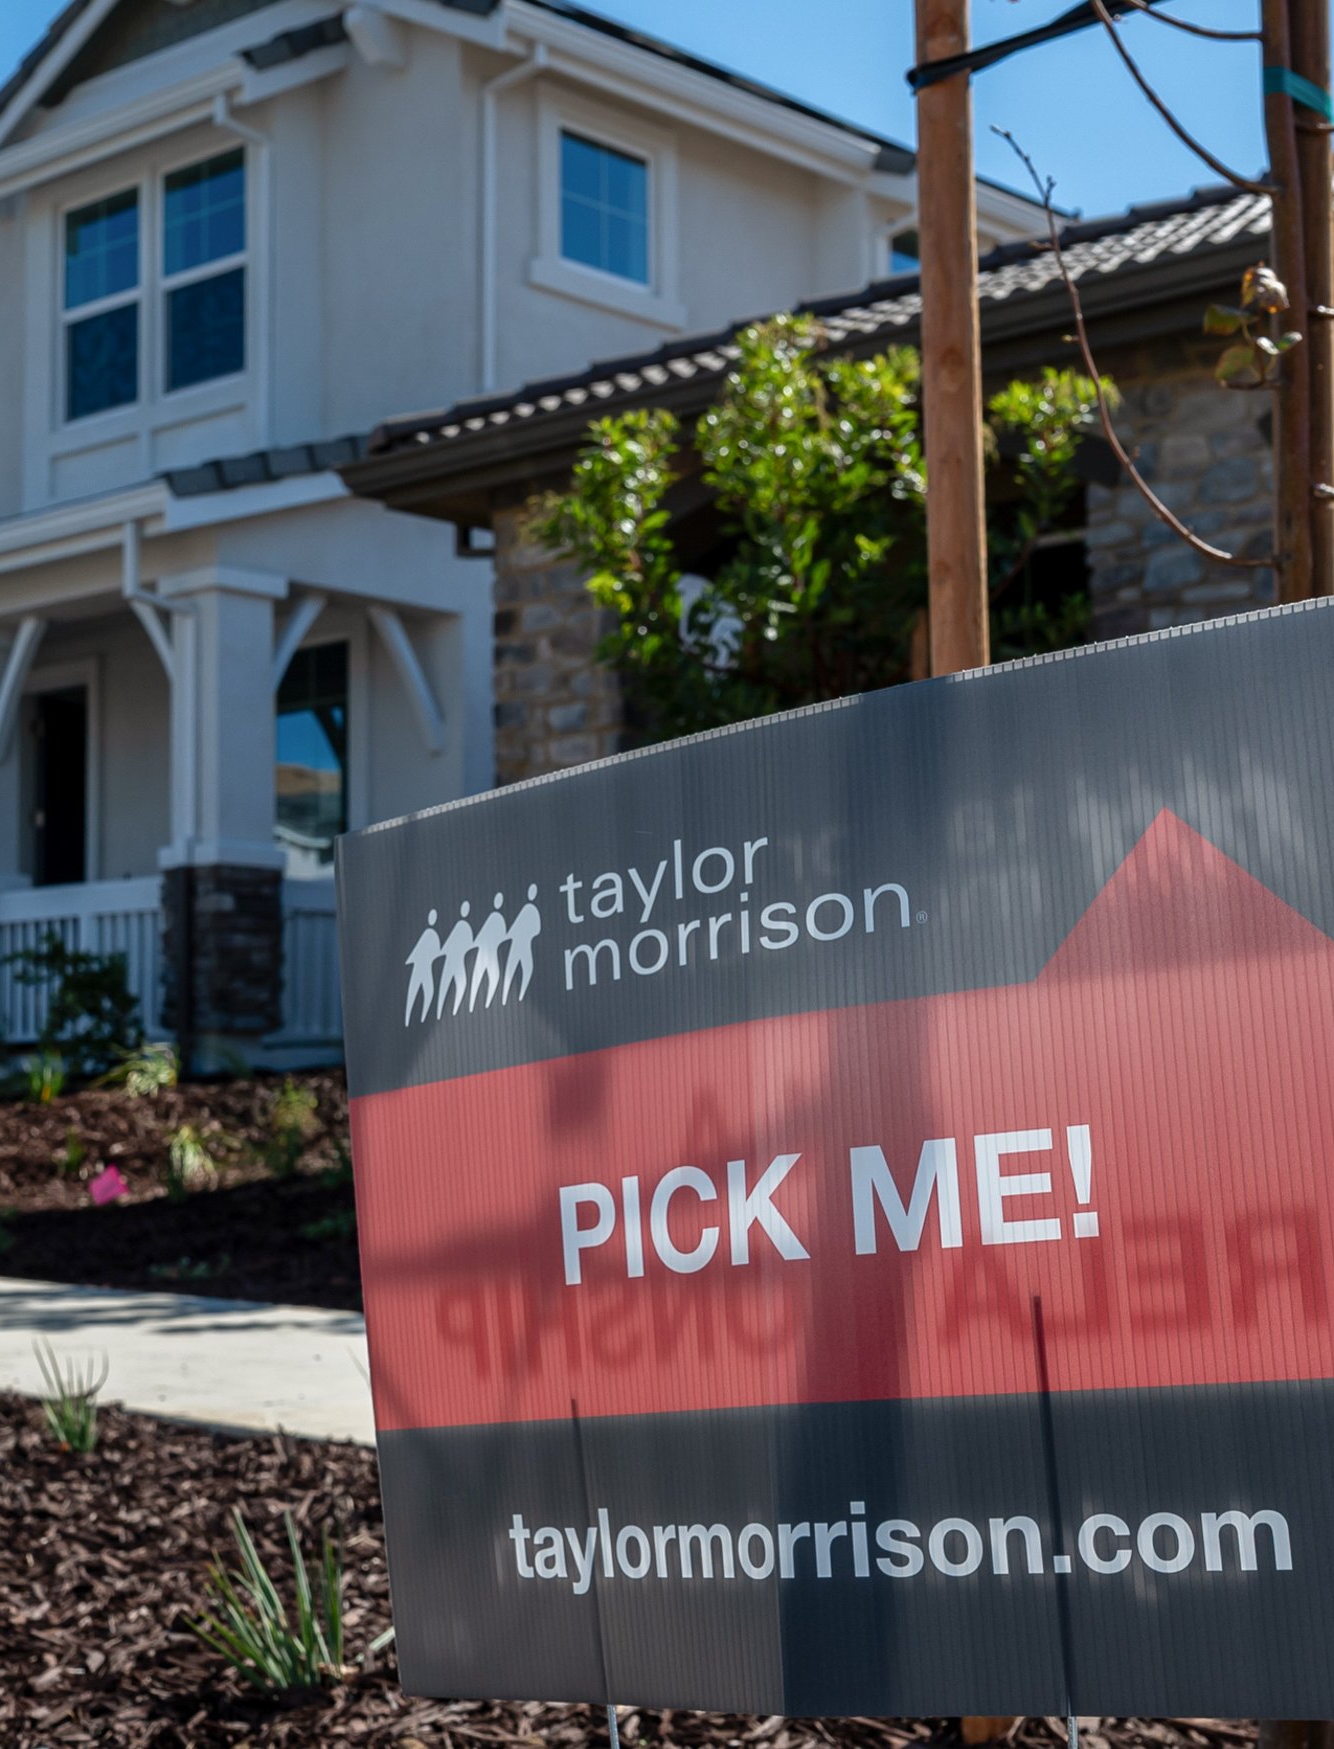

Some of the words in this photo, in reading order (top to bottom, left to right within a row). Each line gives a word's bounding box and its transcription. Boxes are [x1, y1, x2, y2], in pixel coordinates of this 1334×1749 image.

[559, 838, 768, 923] taylor
[559, 1153, 811, 1285] PICK
[849, 1123, 1100, 1255] ME!
[508, 1501, 1293, 1595] taylormorrison.com
